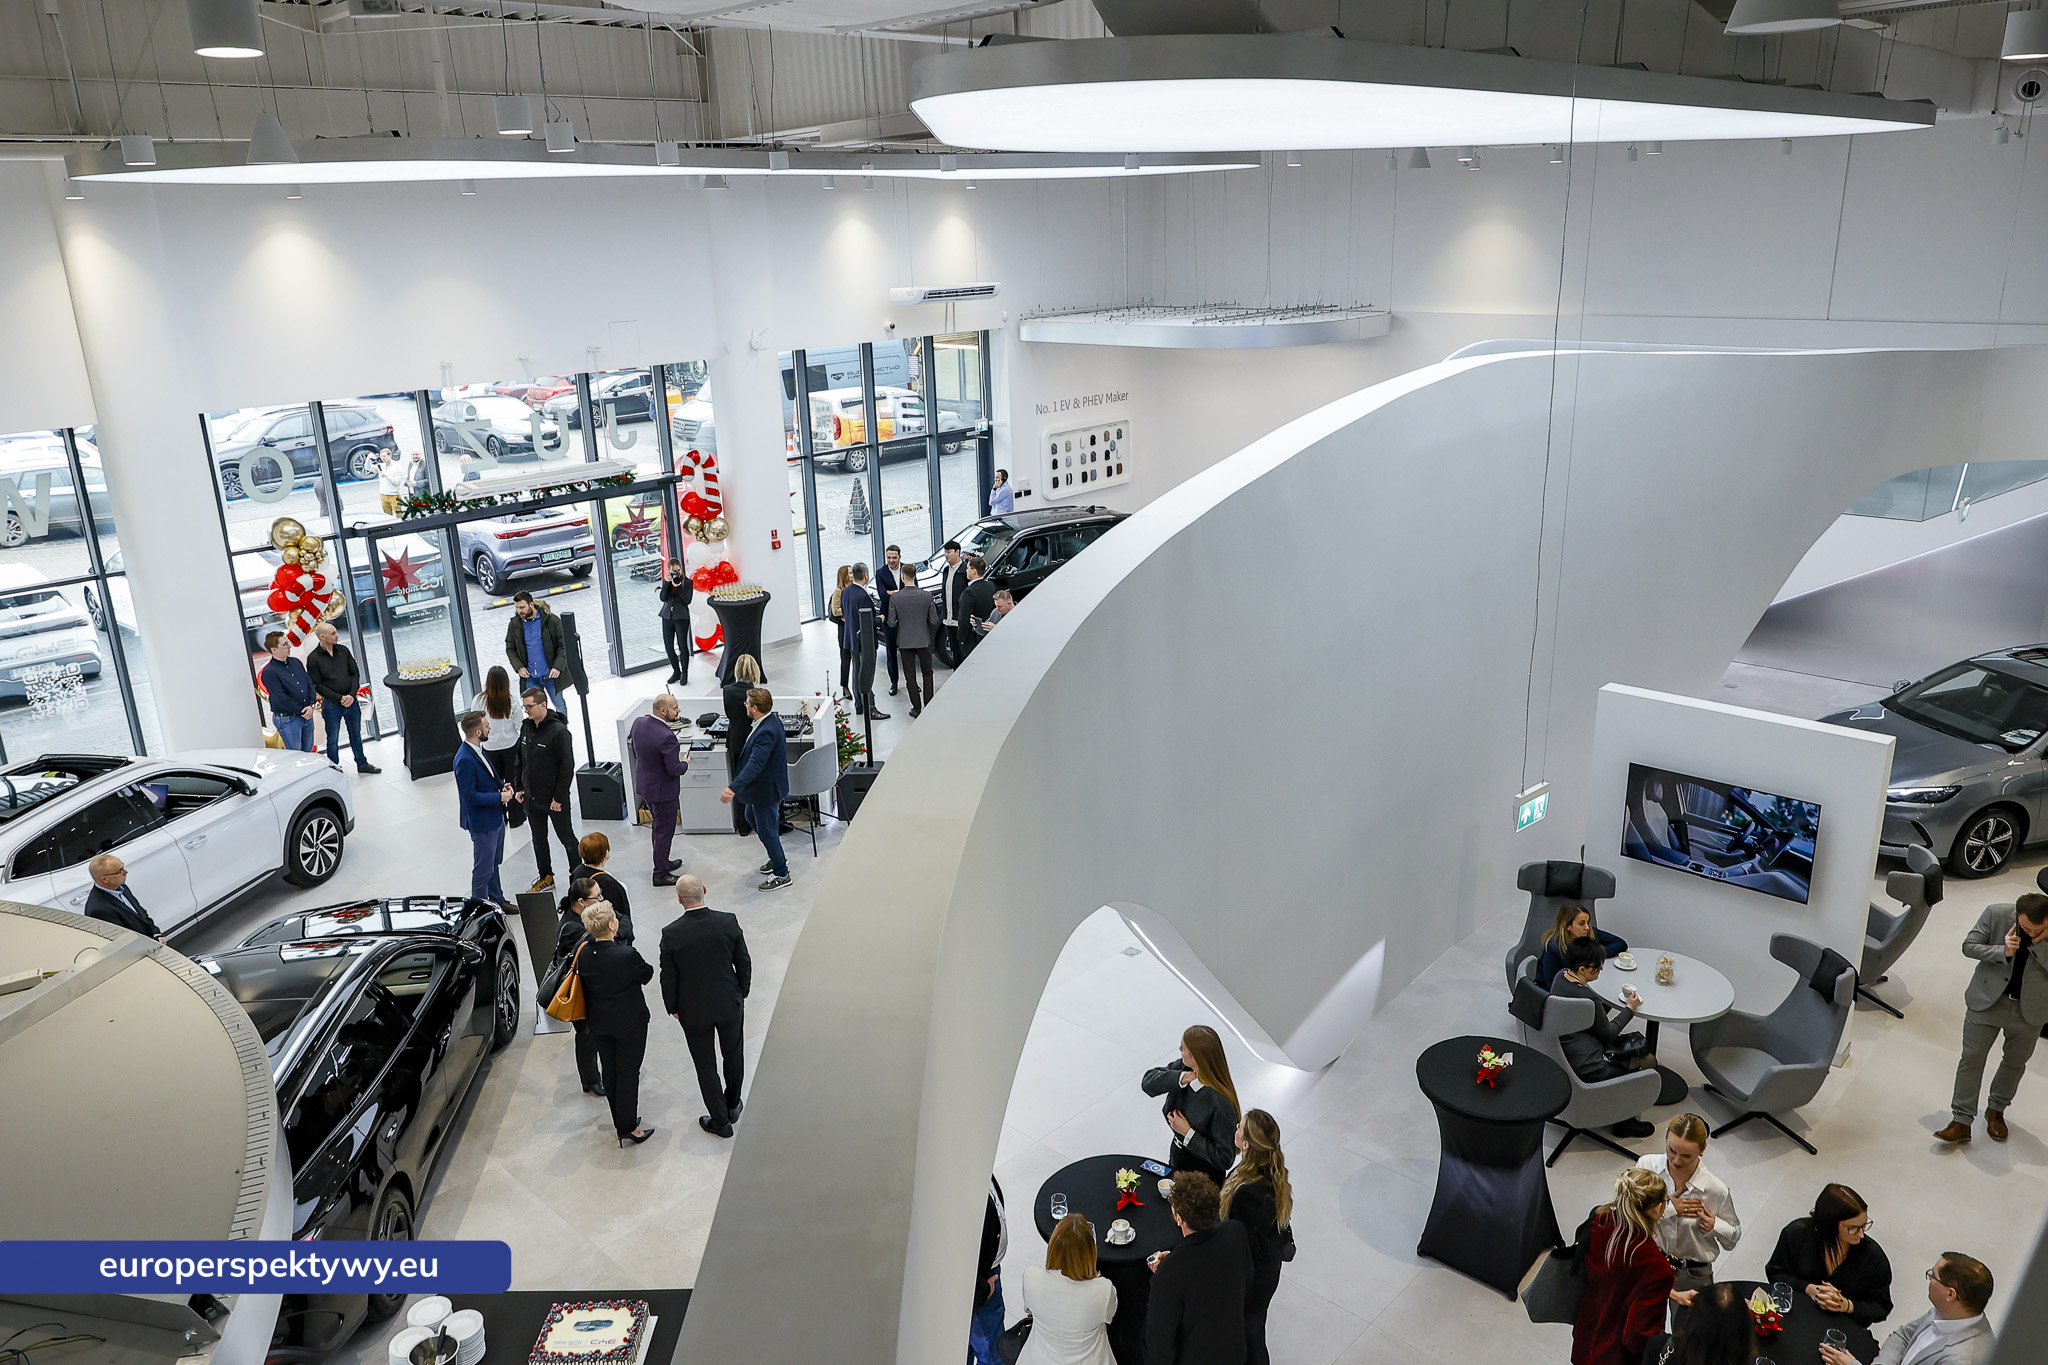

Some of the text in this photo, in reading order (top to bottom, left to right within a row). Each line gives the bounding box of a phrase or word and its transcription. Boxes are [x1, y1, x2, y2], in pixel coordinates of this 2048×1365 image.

[1035, 390, 1129, 415] No. 1 EV & PHEV Maker
